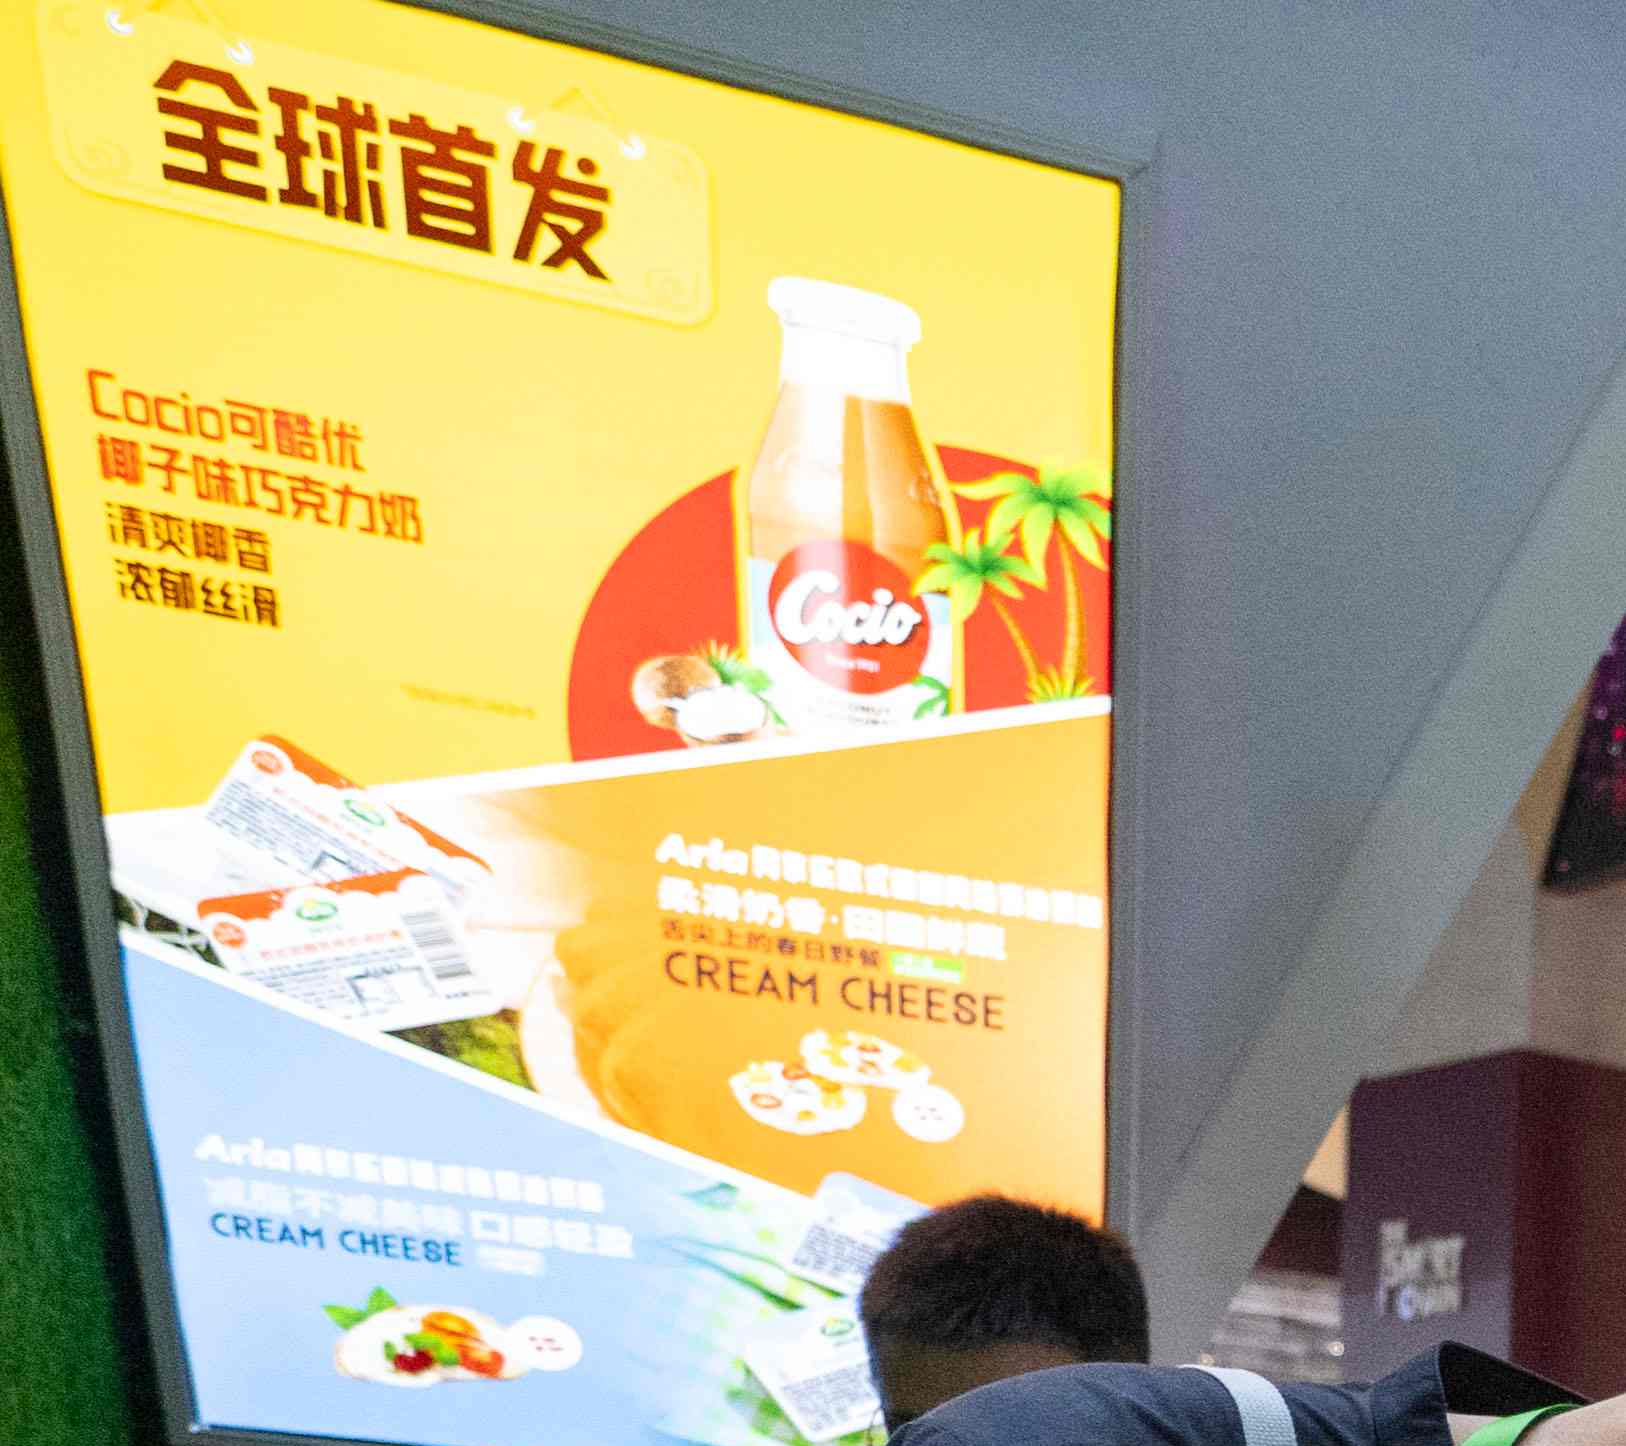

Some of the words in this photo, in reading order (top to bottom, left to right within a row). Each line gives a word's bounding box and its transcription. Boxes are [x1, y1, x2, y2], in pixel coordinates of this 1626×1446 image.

[154, 59, 612, 281] 全球首发
[96, 433, 426, 545] 椰子味巧克力奶
[104, 500, 274, 575] 清爽椰香
[113, 558, 282, 629] 浓郁丝滑
[773, 569, 923, 647] Cocio
[663, 950, 820, 1007] CREAM
[839, 975, 1008, 1031] CHEESE
[209, 1211, 326, 1251] CREAM
[337, 1228, 466, 1268] CHEESE
